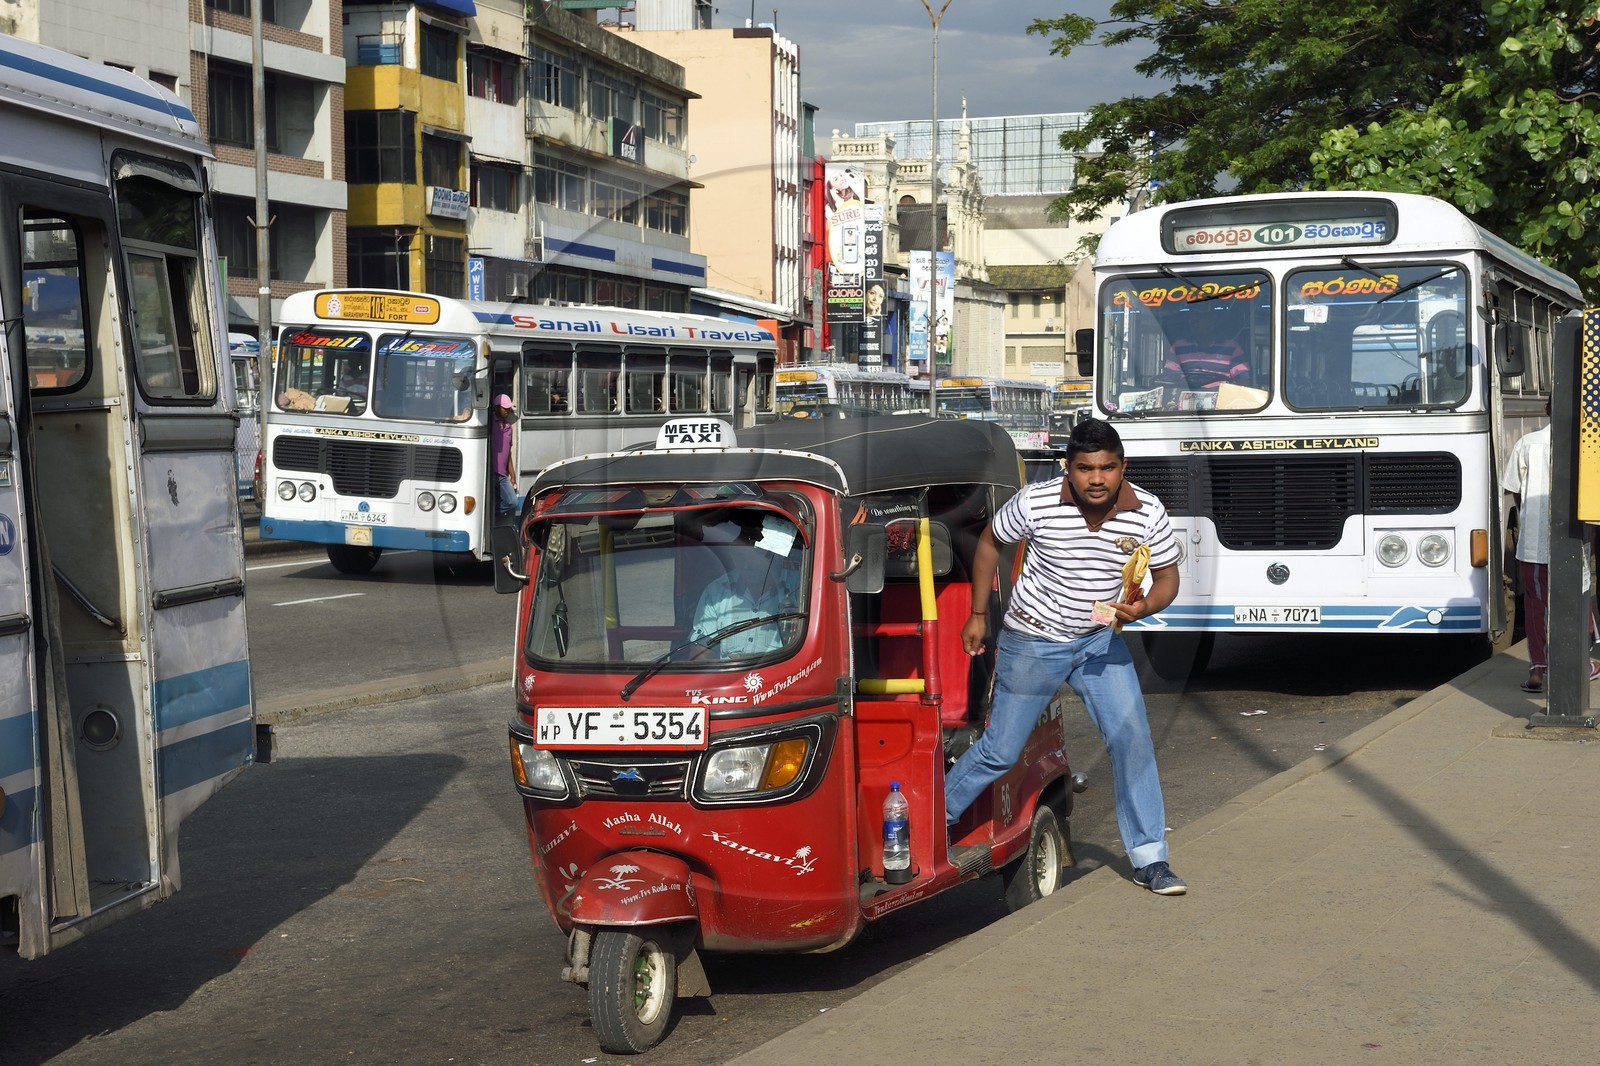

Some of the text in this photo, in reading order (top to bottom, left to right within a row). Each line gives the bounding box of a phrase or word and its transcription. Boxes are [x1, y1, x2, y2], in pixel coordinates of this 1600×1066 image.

[434, 187, 452, 201] ROOMS
[830, 208, 862, 225] SURE
[1186, 228, 1251, 246] මොරටුව
[1259, 227, 1296, 242] 101
[1304, 221, 1386, 239] පිටකොටුව
[828, 289, 863, 297] COLOMBO
[1301, 274, 1399, 297] සරණයි
[371, 296, 385, 319] 103
[1311, 308, 1323, 317] 12
[512, 314, 762, 342] Sanali Lisari Travels
[314, 428, 343, 436] LANKA
[347, 431, 377, 439] ASHOK
[379, 434, 419, 442] LEYLAND
[664, 423, 721, 434] METER
[664, 433, 721, 443] TAXI
[1181, 438, 1379, 451] LANKA ASHOK LEYLAND
[366, 513, 386, 523] 6343
[602, 811, 683, 835] Masha Allah
[701, 830, 797, 866] Xanavi
